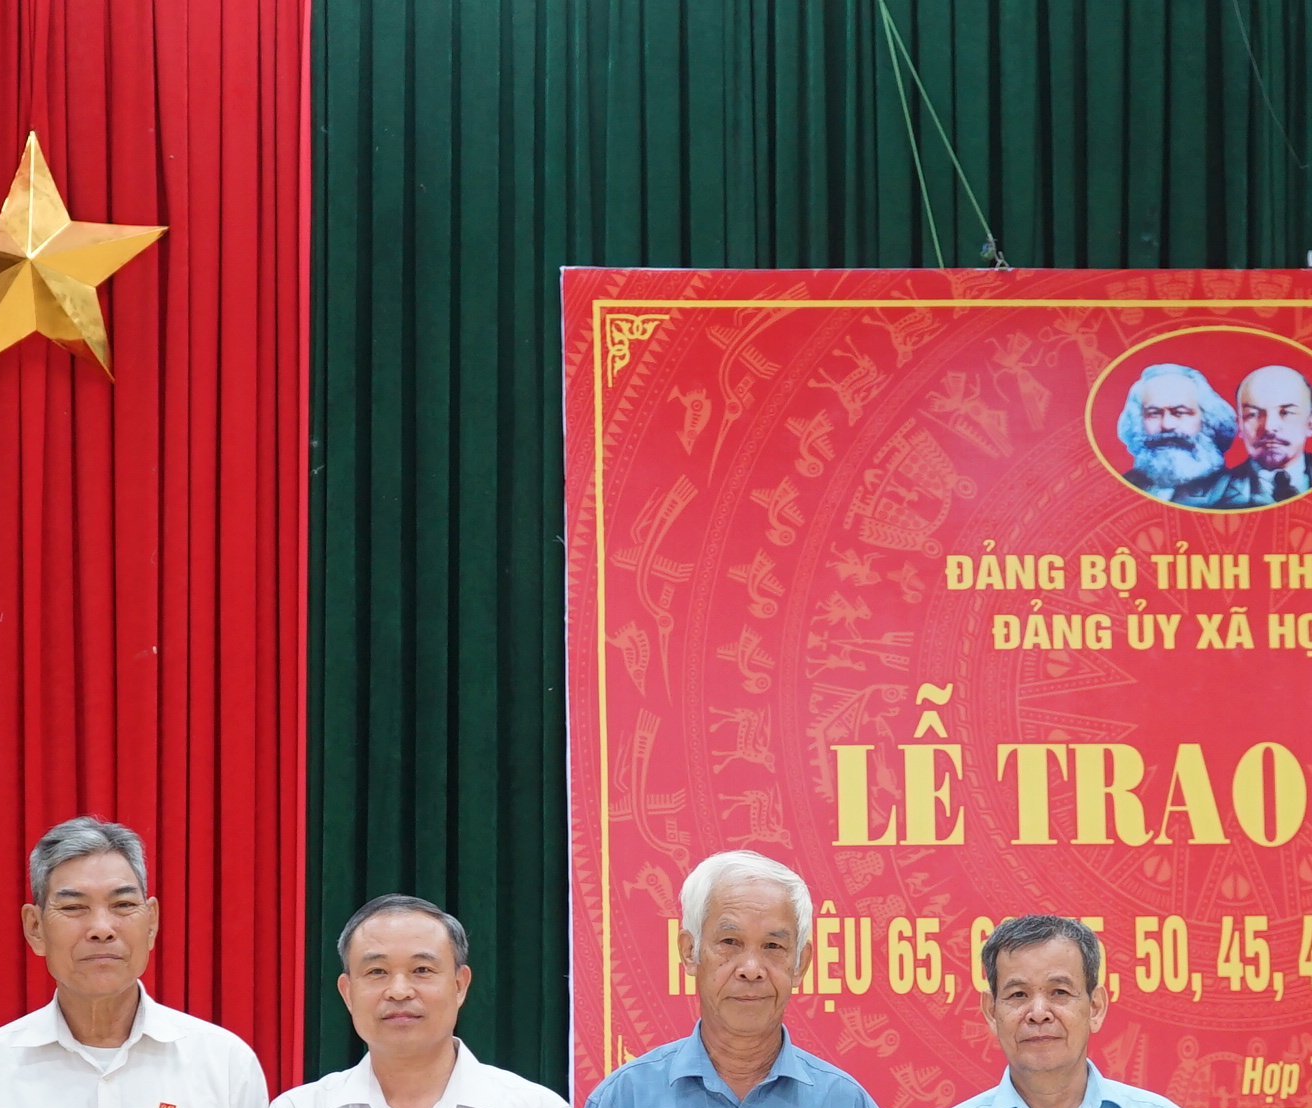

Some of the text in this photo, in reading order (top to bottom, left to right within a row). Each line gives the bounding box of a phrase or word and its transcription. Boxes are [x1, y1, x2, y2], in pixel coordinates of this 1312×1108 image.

[945, 540, 1065, 590] ĐẢNG
[1080, 547, 1137, 598] BỘ
[1151, 541, 1250, 590] TỈNH
[992, 599, 1112, 650] ĐẢNG
[1127, 599, 1181, 650] ỦY
[1196, 607, 1254, 649] XÃ
[831, 684, 965, 847] LỄ
[997, 741, 1307, 848] TRAO
[889, 917, 956, 1002] 65,
[1135, 916, 1202, 1001] 50,
[1218, 916, 1284, 1001] 45,
[1241, 1056, 1300, 1103] Hợp
